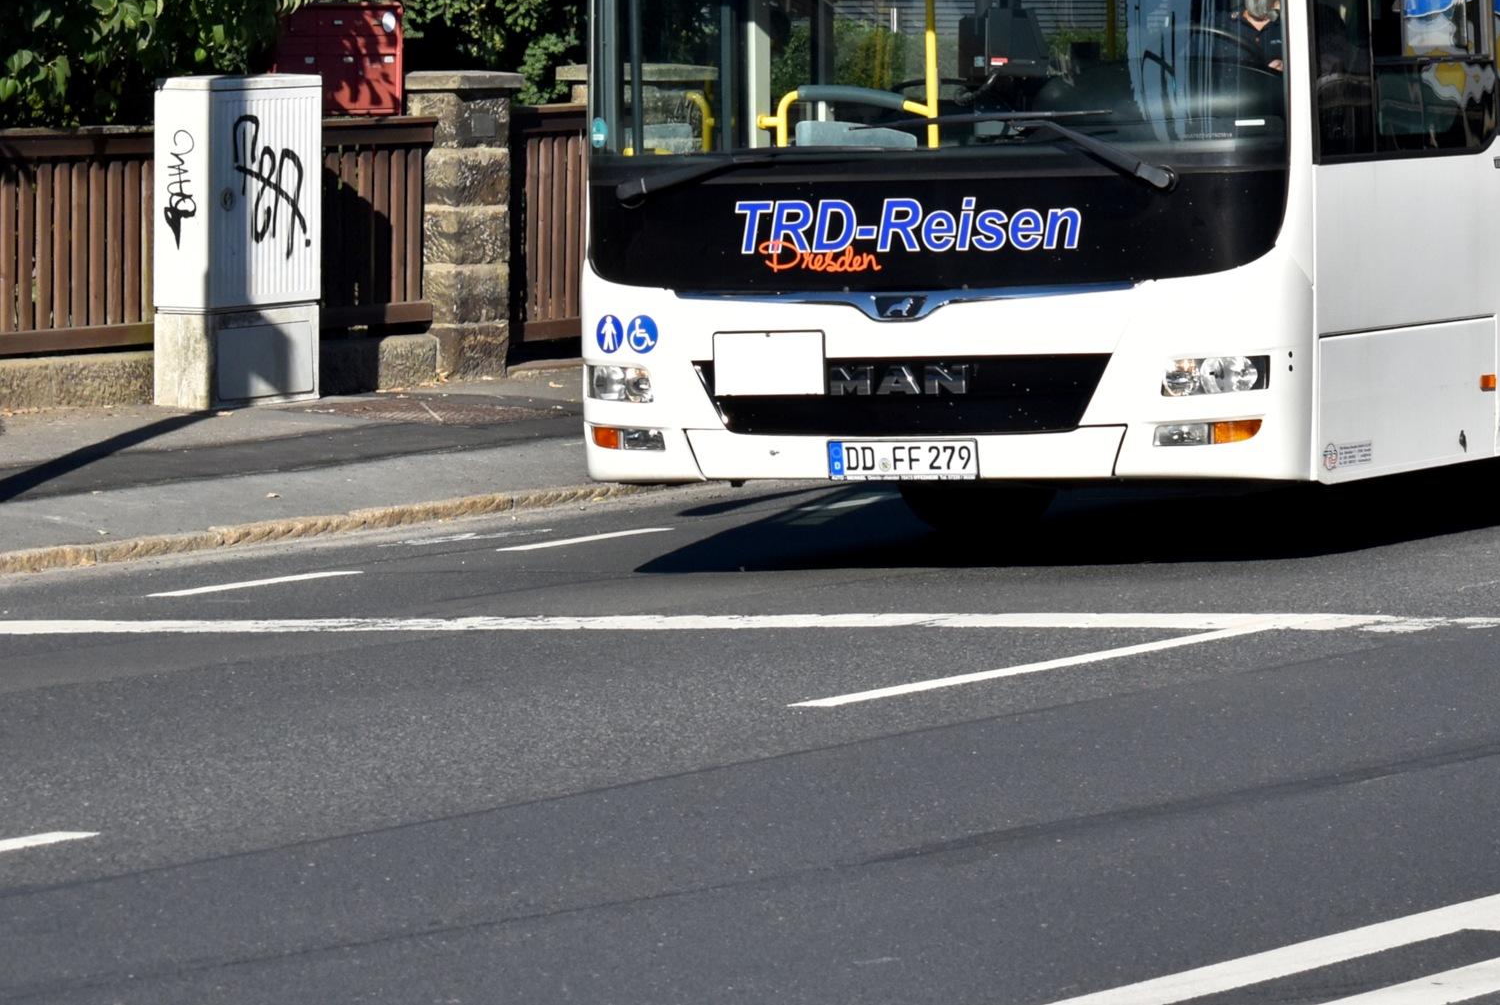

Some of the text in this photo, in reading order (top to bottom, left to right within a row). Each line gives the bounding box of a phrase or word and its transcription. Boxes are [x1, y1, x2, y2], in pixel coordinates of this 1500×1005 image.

[735, 197, 1082, 254] TRD-Reisen
[759, 239, 881, 272] Dresden
[830, 364, 967, 396] MAN
[845, 446, 875, 471] DD
[892, 446, 921, 471] FF
[928, 446, 971, 470] 279
